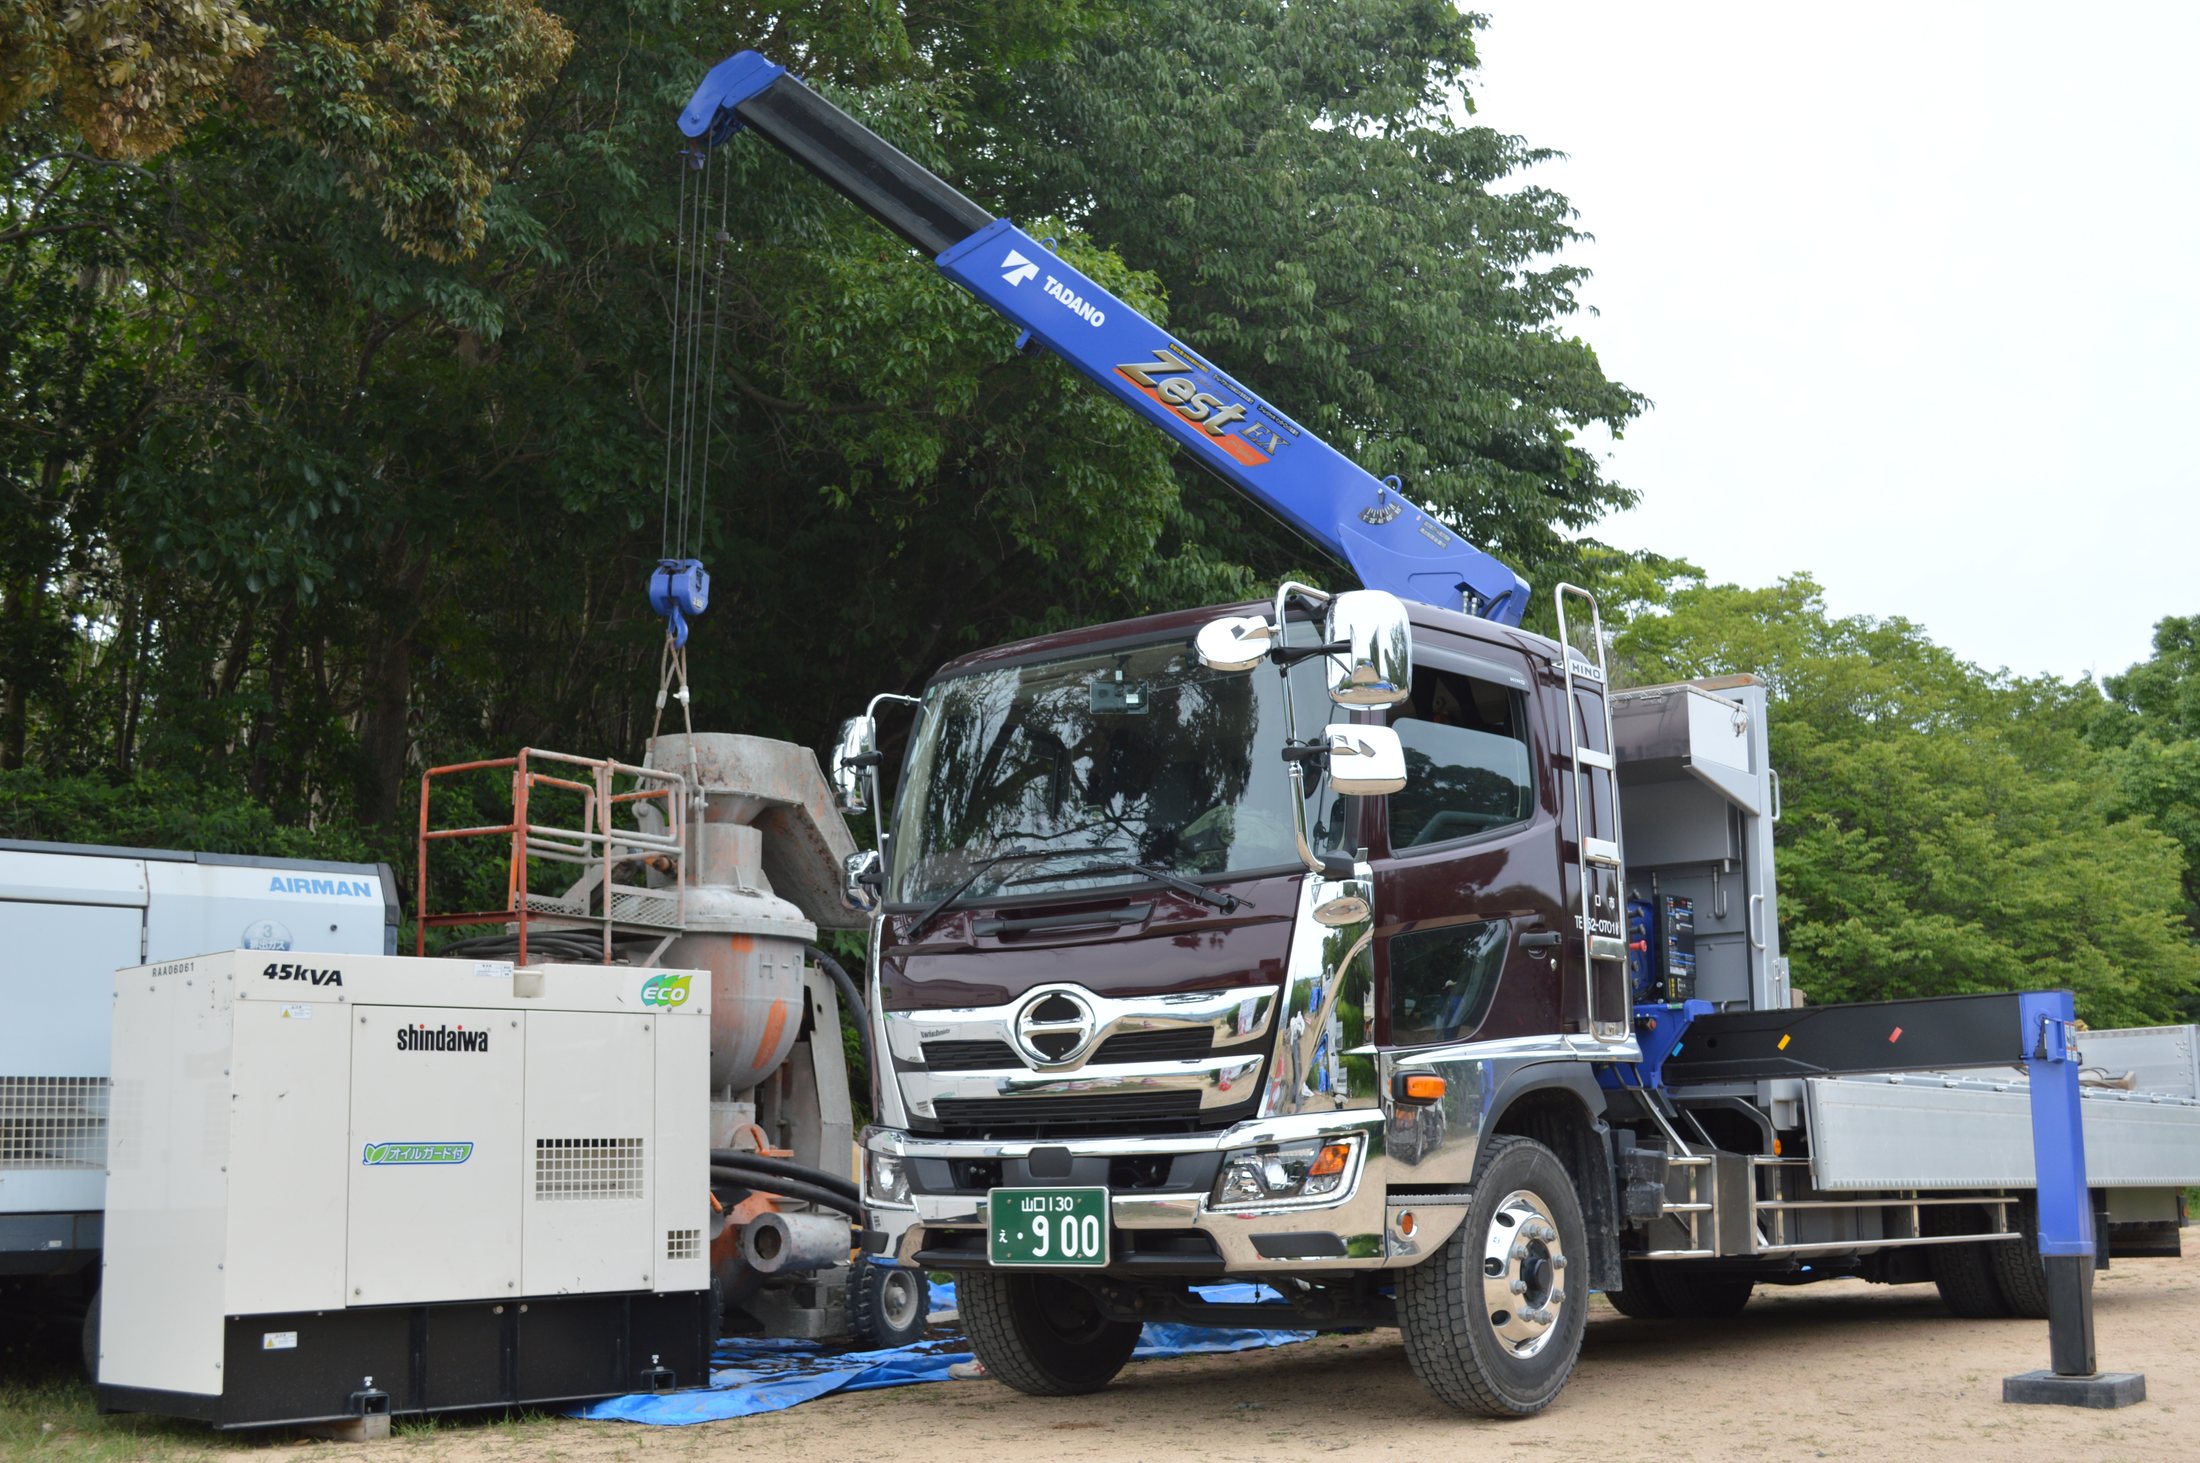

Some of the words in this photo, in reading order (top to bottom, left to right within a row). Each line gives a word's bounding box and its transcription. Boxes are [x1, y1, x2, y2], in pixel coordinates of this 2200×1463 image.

[1043, 275, 1105, 328] TADANO
[1117, 350, 1246, 436] Zest
[1241, 422, 1291, 456] EX
[1572, 663, 1601, 680] HINO
[270, 877, 371, 897] AIRMAN
[263, 924, 272, 938] 3
[152, 963, 195, 977] RAA06061
[263, 964, 343, 986] 45kVA
[643, 987, 686, 1001] ECO
[397, 1024, 488, 1052] shindaiwa
[390, 1147, 464, 1160] オイルガード付
